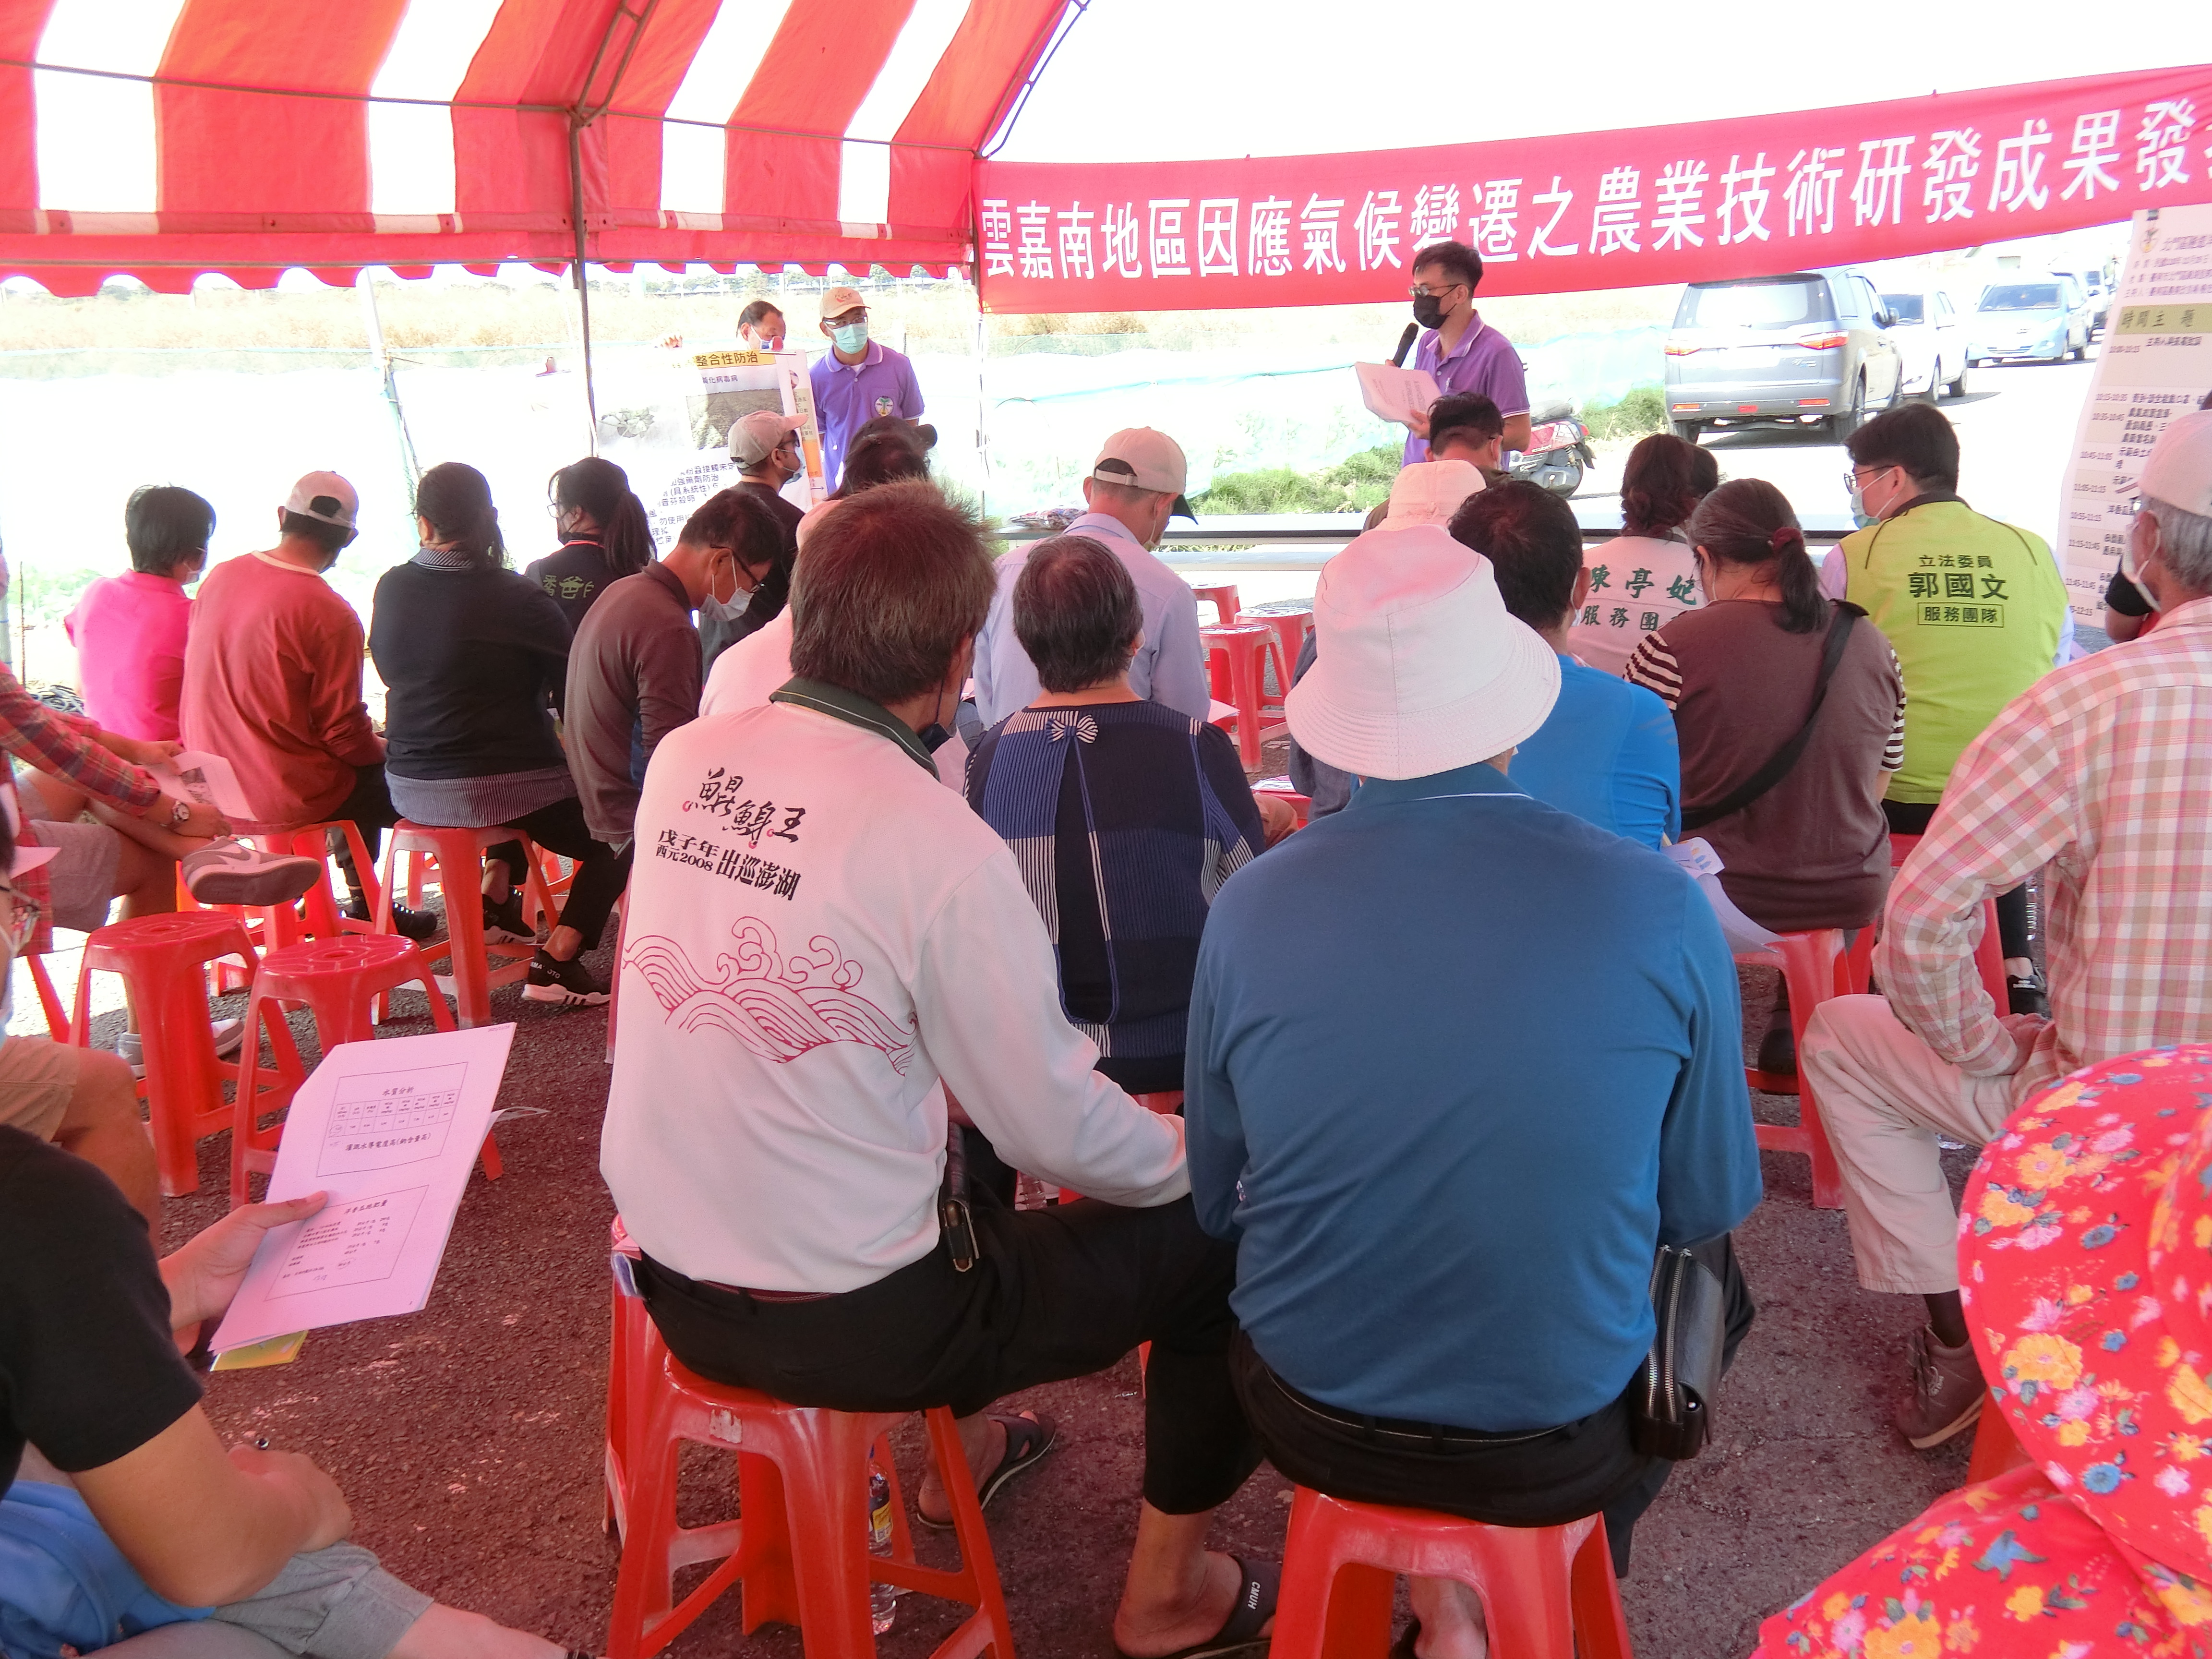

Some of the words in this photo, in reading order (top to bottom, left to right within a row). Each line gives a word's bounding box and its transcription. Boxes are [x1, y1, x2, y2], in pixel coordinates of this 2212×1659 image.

[982, 97, 2212, 279] 雲嘉南地區因應氣候變遷之農業技術研發成果發
[680, 462, 735, 476] 粉蝨接觸未定
[1919, 554, 1994, 569] 立法委員
[1907, 572, 2009, 601] 郭國文
[1581, 605, 1680, 632] 服務團
[1924, 606, 1998, 624] 服務團隊
[655, 843, 714, 871] 西元2008
[658, 829, 721, 857] 戊子年
[715, 849, 802, 901] 出巡澎湖
[1248, 1581, 1261, 1610] CMUH
